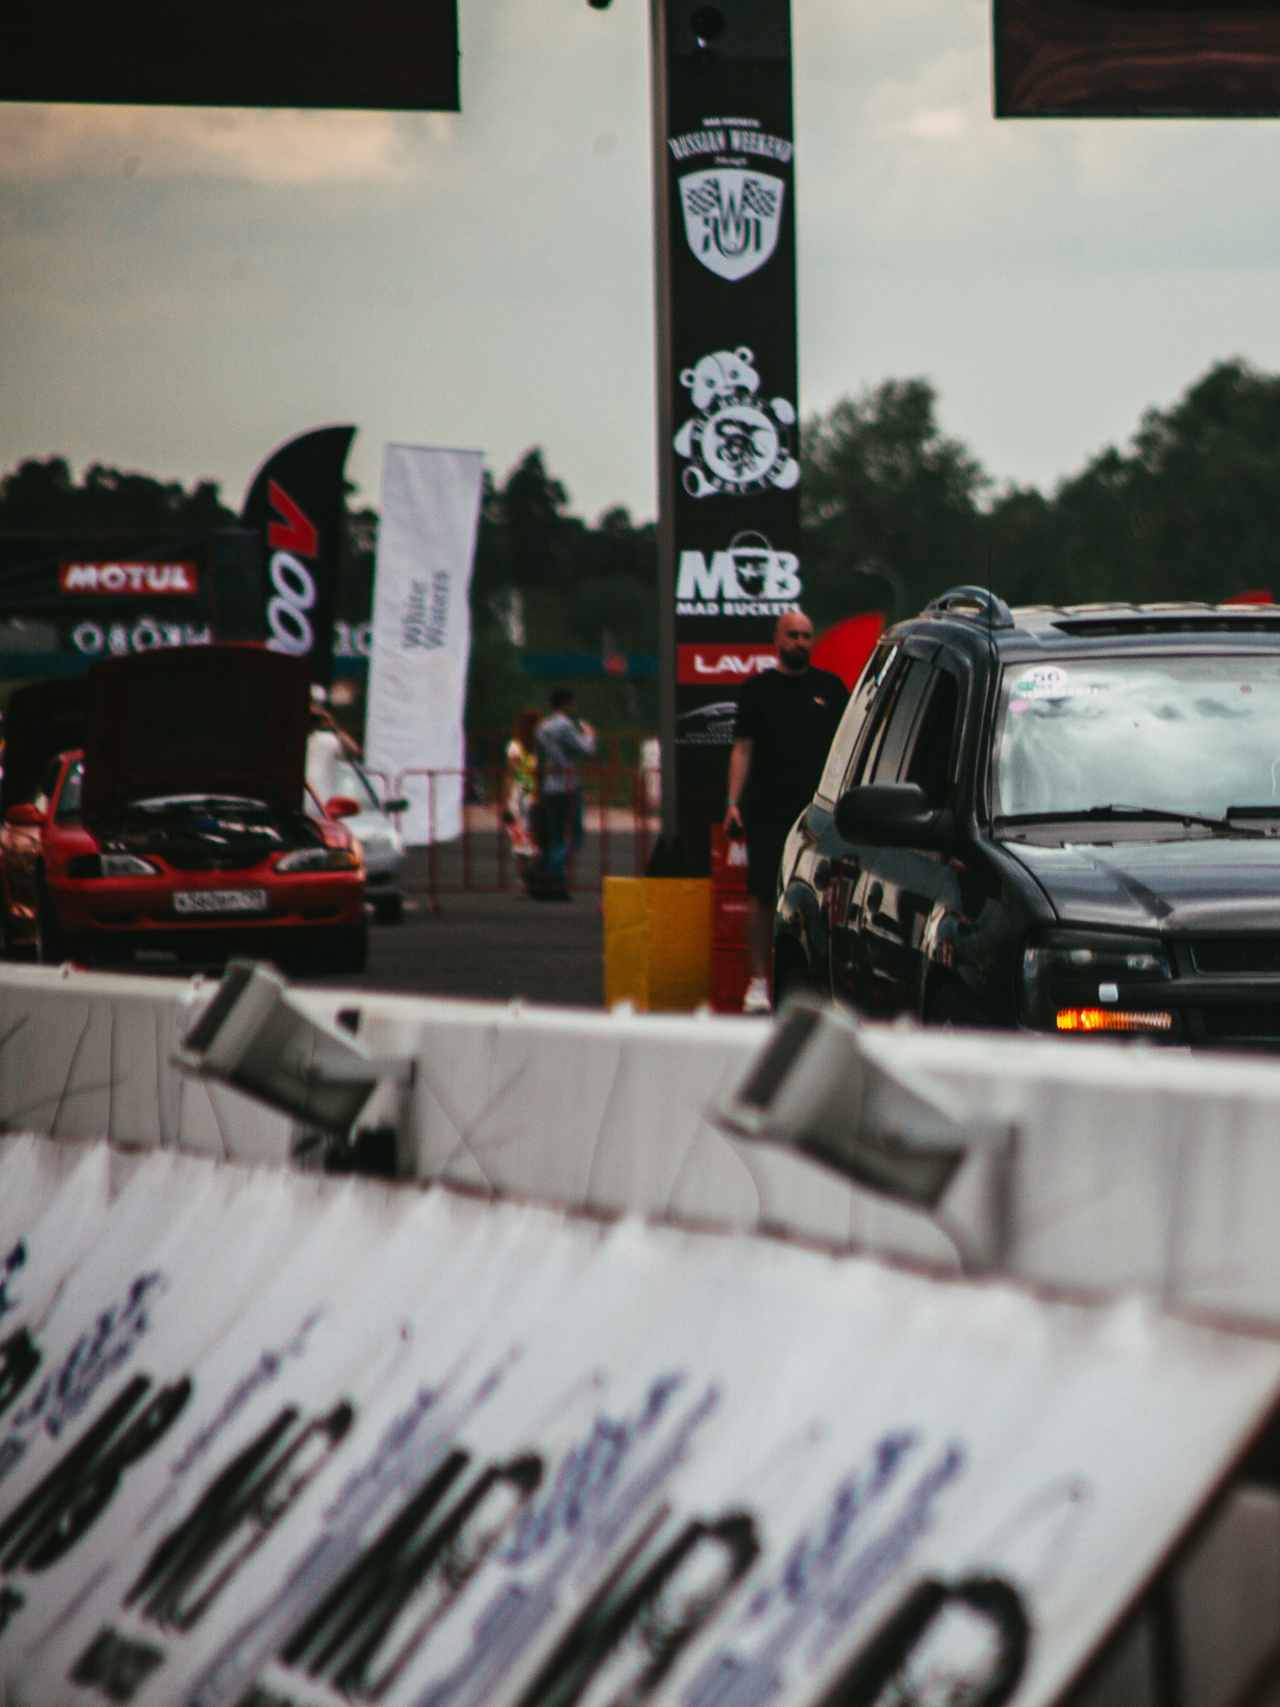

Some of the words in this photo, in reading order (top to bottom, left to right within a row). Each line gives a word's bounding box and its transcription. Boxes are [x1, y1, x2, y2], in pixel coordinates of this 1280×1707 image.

[668, 129, 727, 160] RUSSIAN
[729, 129, 793, 163] WEEKEND
[65, 563, 189, 589] MOTUL
[676, 602, 720, 616] MAD
